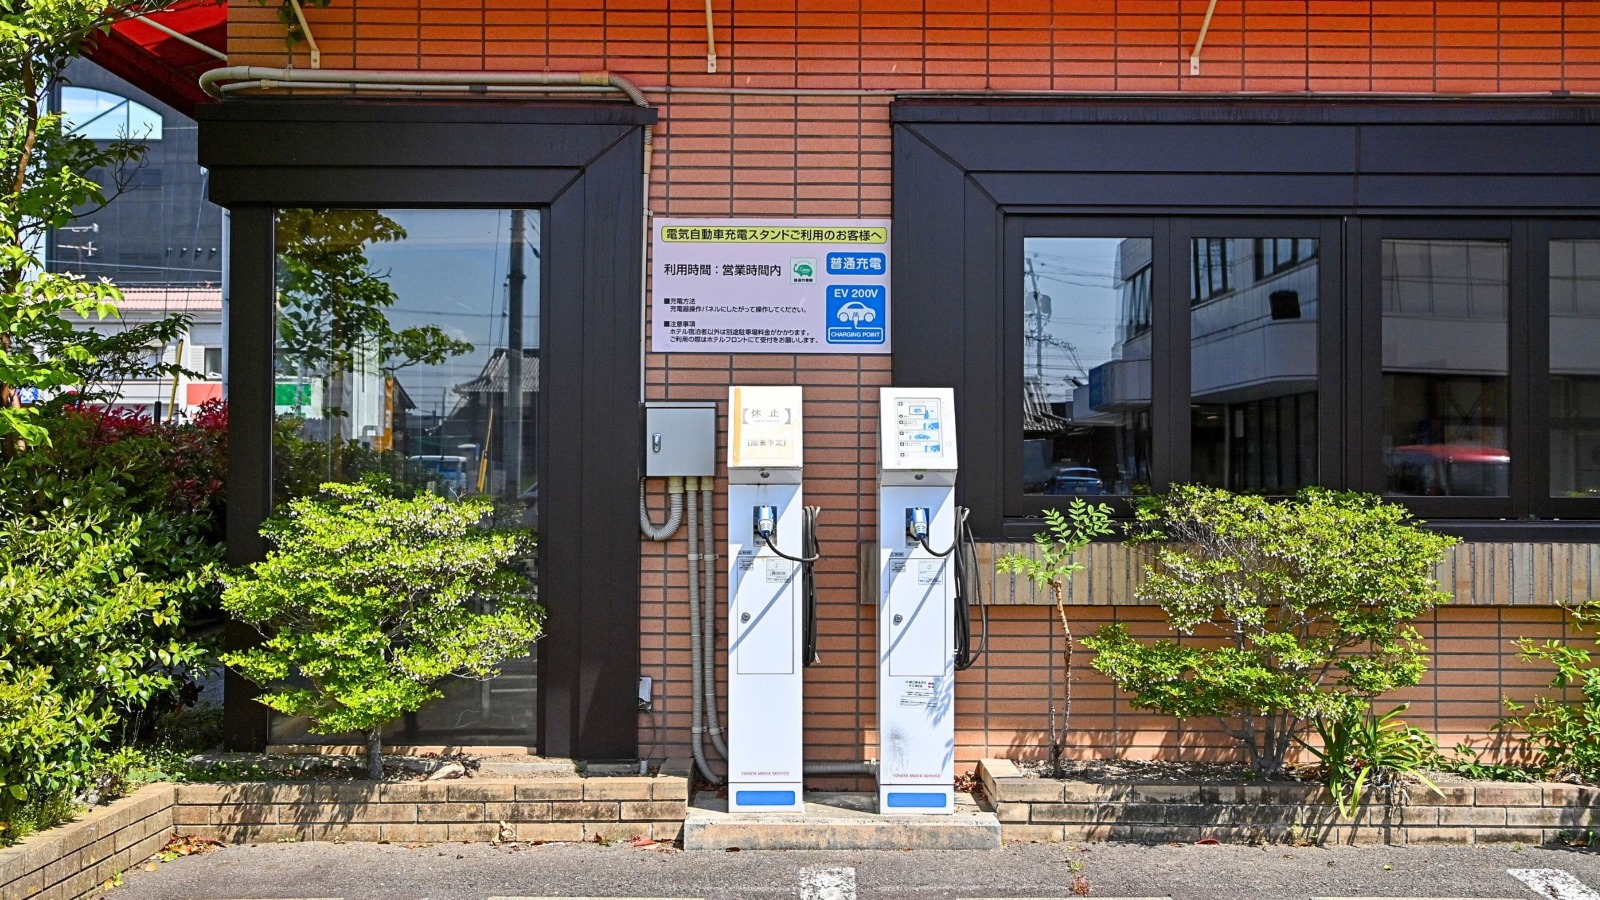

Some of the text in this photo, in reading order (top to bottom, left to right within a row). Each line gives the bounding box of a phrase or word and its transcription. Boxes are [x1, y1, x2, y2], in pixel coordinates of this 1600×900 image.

[666, 228, 882, 242] 電気自動車充電スタンドご利用のお客様へ
[830, 257, 882, 270] 普通充電
[663, 264, 781, 277] 利用時間：営業時間内
[834, 288, 878, 298] EV 200V
